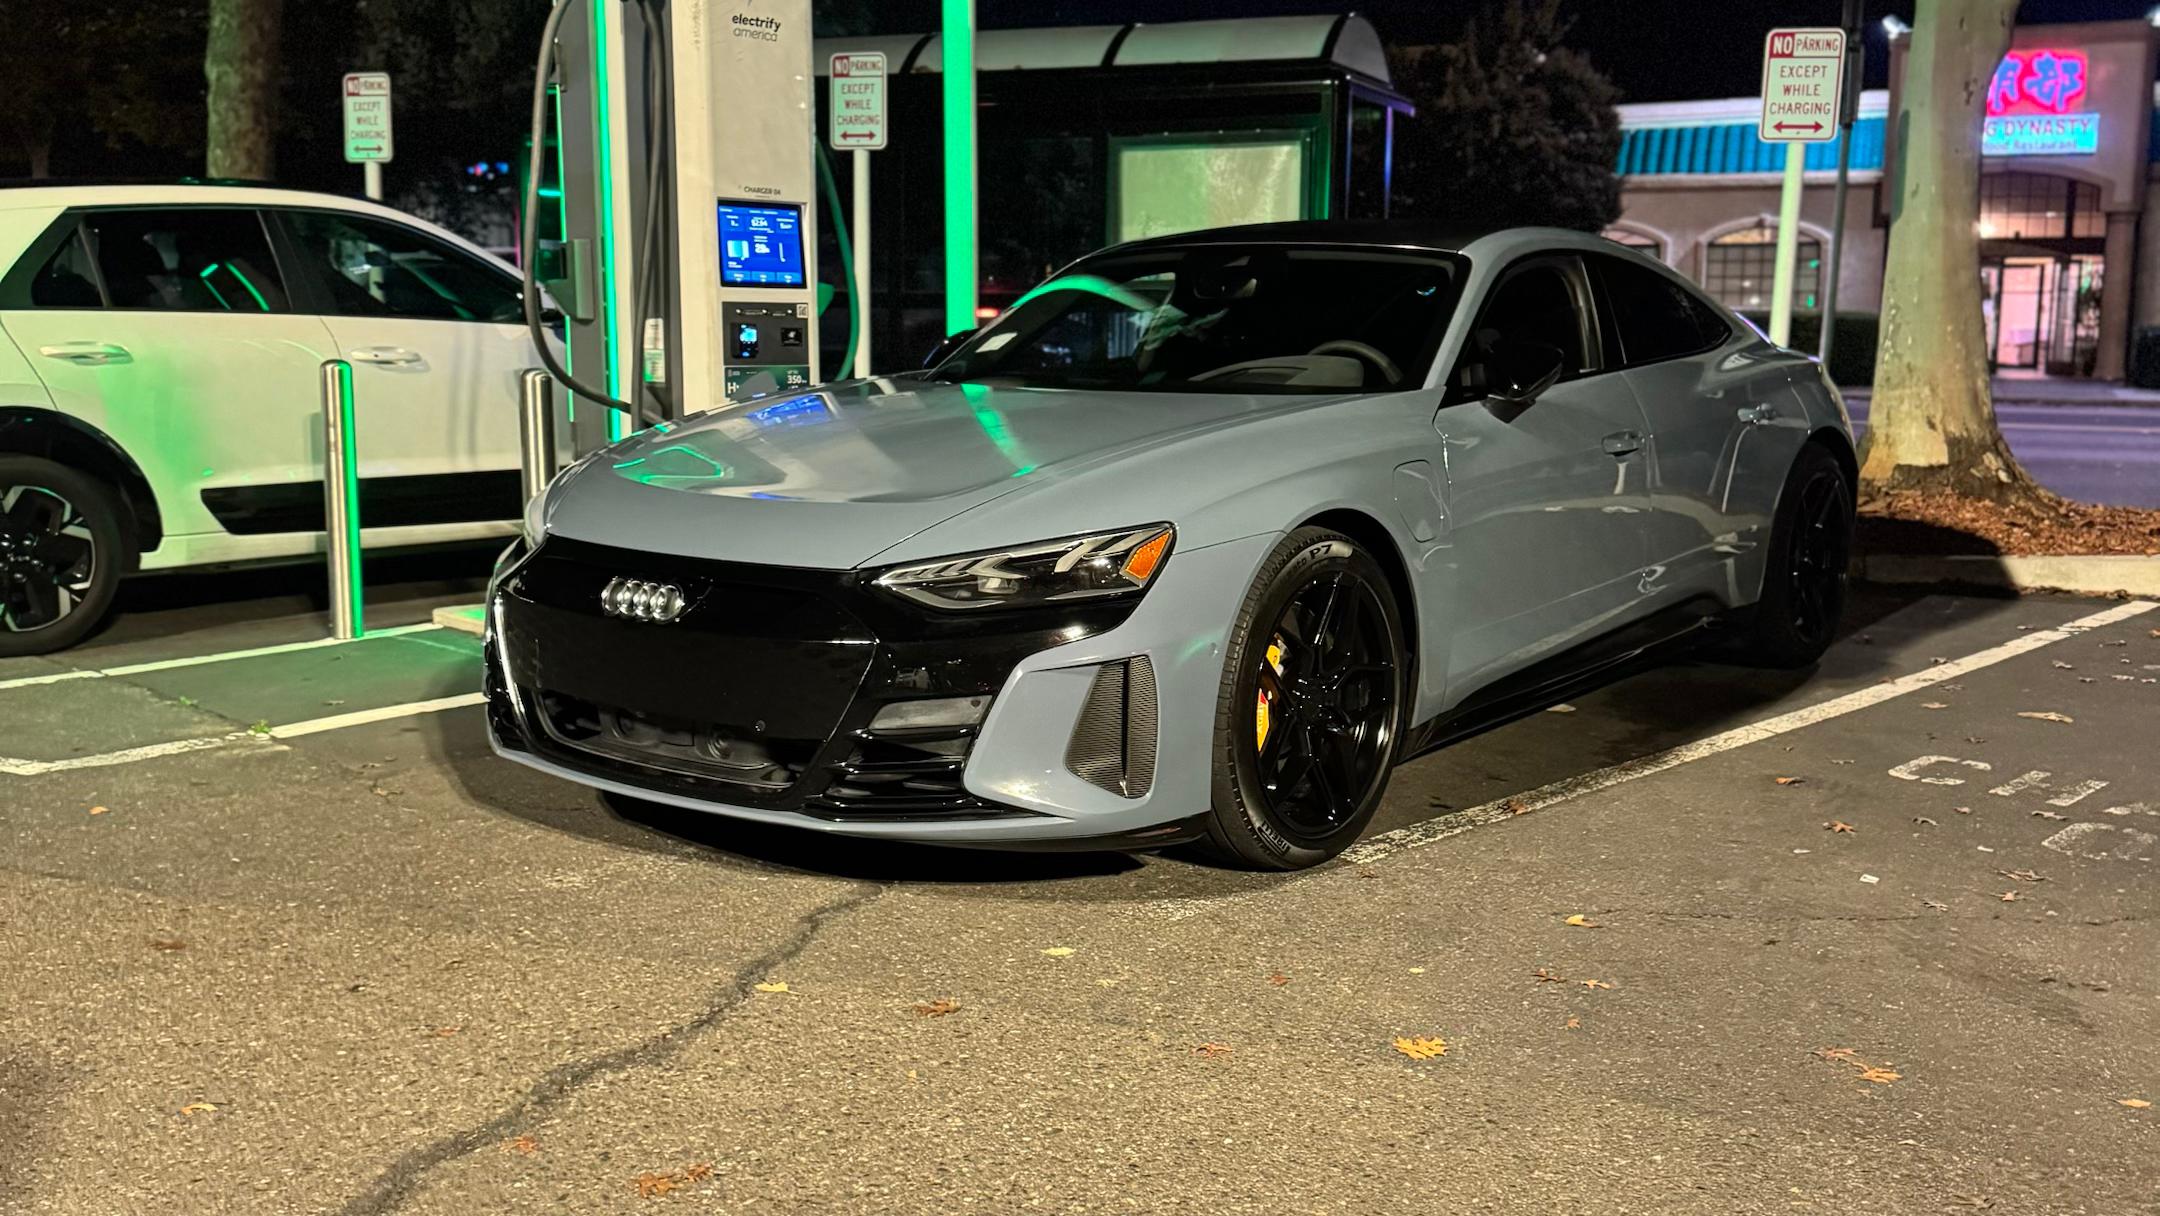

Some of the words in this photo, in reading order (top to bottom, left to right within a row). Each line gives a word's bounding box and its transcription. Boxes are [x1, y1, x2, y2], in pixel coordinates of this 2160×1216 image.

[732, 13, 781, 33] electrify
[733, 27, 778, 42] america
[1773, 35, 1793, 55] NO
[1796, 38, 1839, 52] PARKING
[834, 58, 849, 75] NO
[850, 61, 881, 72] PARKING
[1780, 65, 1828, 78] EXCEPT
[841, 83, 875, 95] EXCEPT
[1783, 84, 1821, 97] WHILE
[353, 101, 381, 112] EXCEPT
[844, 99, 872, 110] WHILE
[1769, 102, 1831, 115] CHARGING
[356, 115, 379, 126] WHILE
[837, 114, 881, 126] CHARGING
[2004, 118, 2090, 136] DYNASTY
[787, 375, 802, 384] 350
